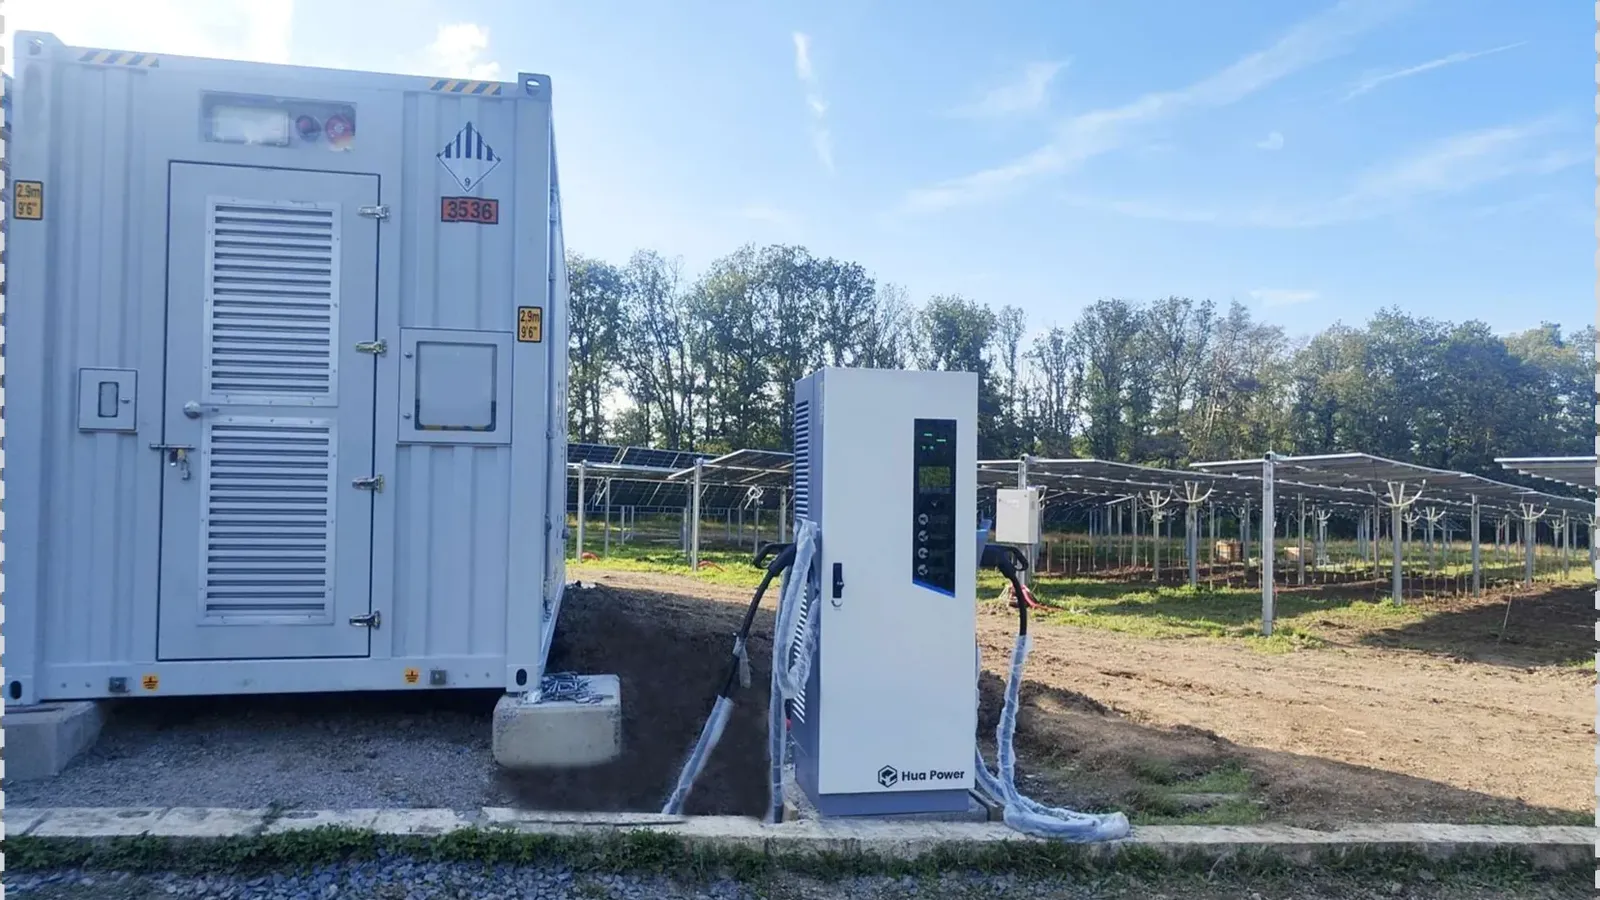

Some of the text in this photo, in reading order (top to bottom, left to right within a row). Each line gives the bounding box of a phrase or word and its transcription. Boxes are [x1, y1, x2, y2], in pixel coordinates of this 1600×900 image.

[464, 177, 471, 188] 9
[447, 200, 493, 220] 3536
[901, 769, 965, 781] Hua Power
